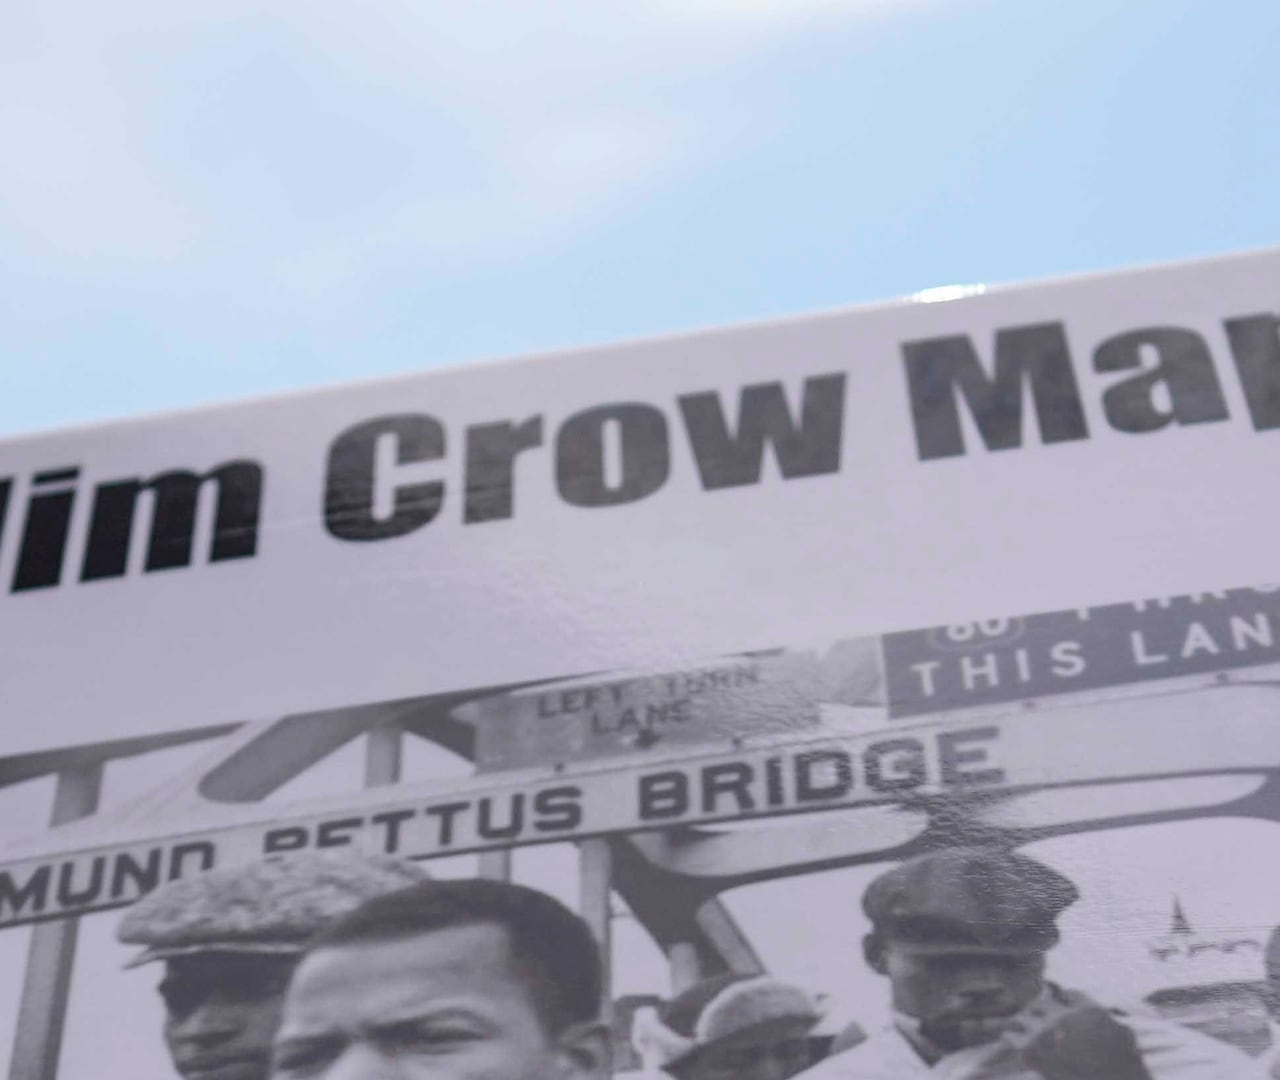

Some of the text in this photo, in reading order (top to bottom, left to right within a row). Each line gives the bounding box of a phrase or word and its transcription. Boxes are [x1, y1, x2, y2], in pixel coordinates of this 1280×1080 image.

[321, 371, 848, 544] Crow
[537, 682, 624, 720] LEFT
[909, 640, 1087, 698] THIS
[638, 725, 1006, 821] BRIDGE
